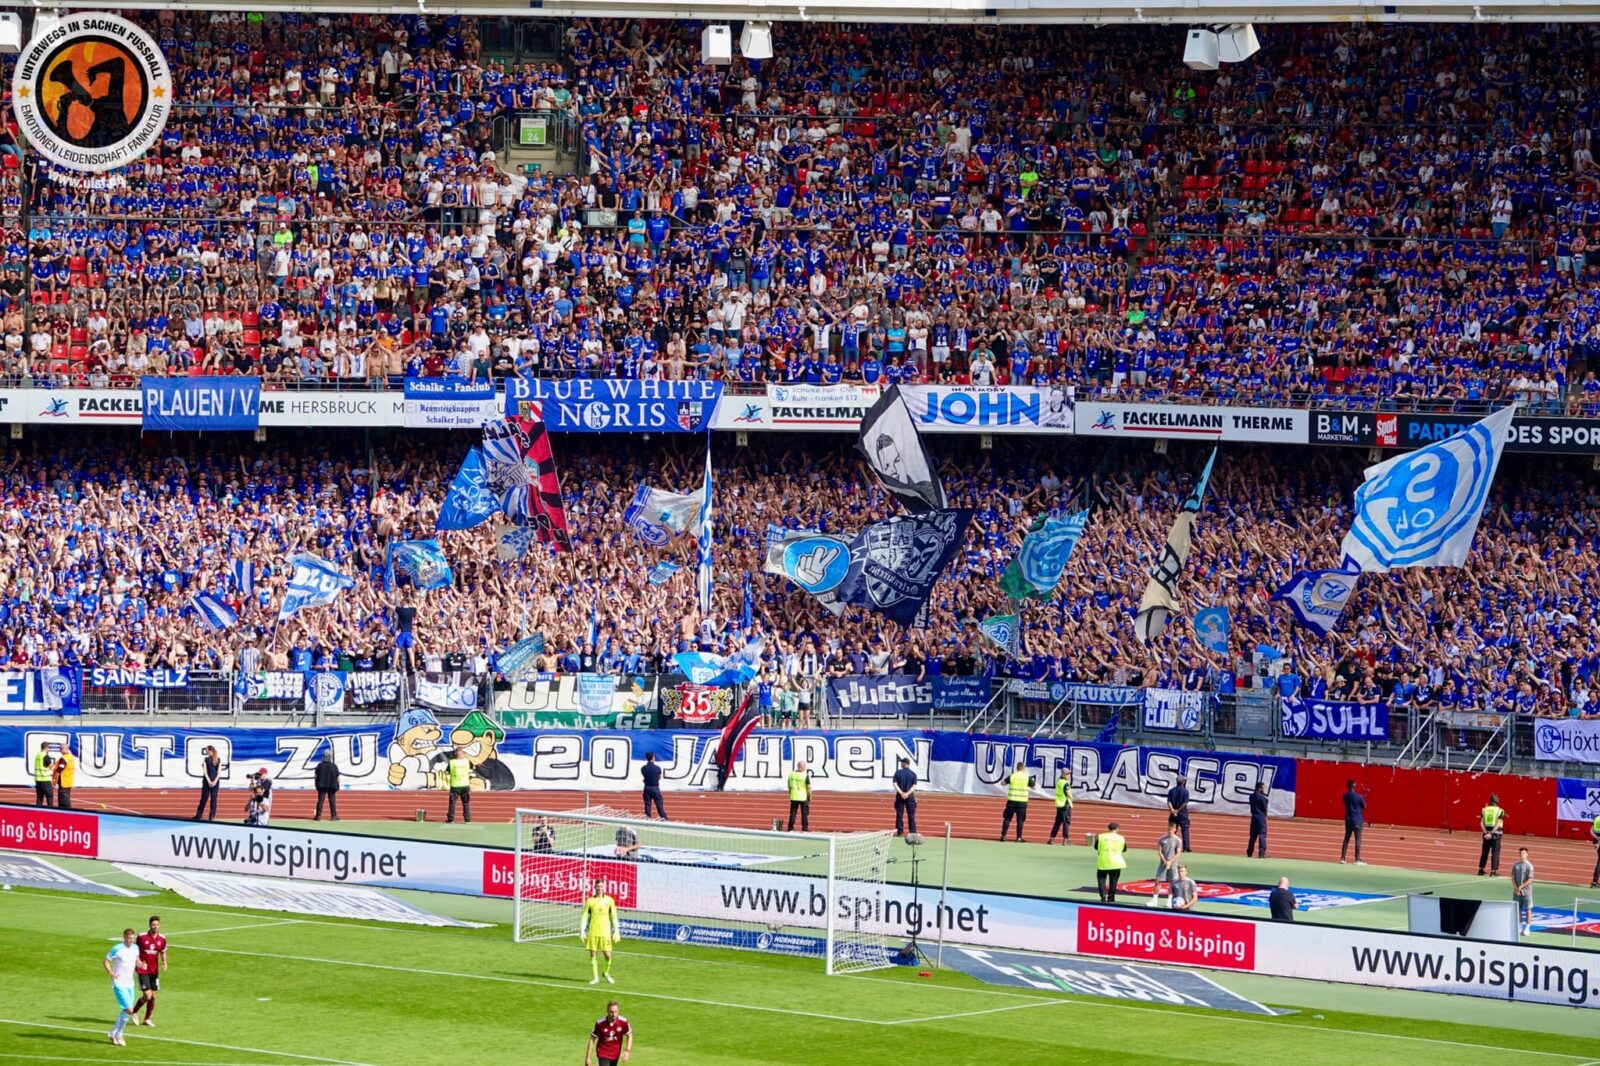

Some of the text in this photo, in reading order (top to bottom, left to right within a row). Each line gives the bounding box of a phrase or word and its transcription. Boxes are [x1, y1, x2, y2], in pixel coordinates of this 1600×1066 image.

[527, 132, 539, 142] 24
[409, 381, 444, 392] Schalke
[454, 382, 490, 392] Fanclub
[512, 378, 716, 399] BLUE WHITE
[147, 388, 225, 417] PLAUEN
[239, 388, 255, 416] V.
[291, 401, 376, 414] HERSBRUCK
[920, 391, 1040, 425] JOHN
[1123, 411, 1293, 430] FACKELMANN THERME
[1318, 415, 1358, 434] B&M
[1376, 416, 1397, 437] Sport
[1505, 426, 1542, 443] DES
[682, 690, 712, 715] 35
[1312, 704, 1385, 736] SUHL
[275, 732, 380, 781] ZU
[534, 735, 631, 781] 20
[26, 821, 36, 839] &
[39, 822, 91, 849] bisping
[171, 832, 407, 881] www.bisping.net
[720, 882, 989, 937] www.bsping.net
[1087, 917, 1246, 960] bisping & bisping
